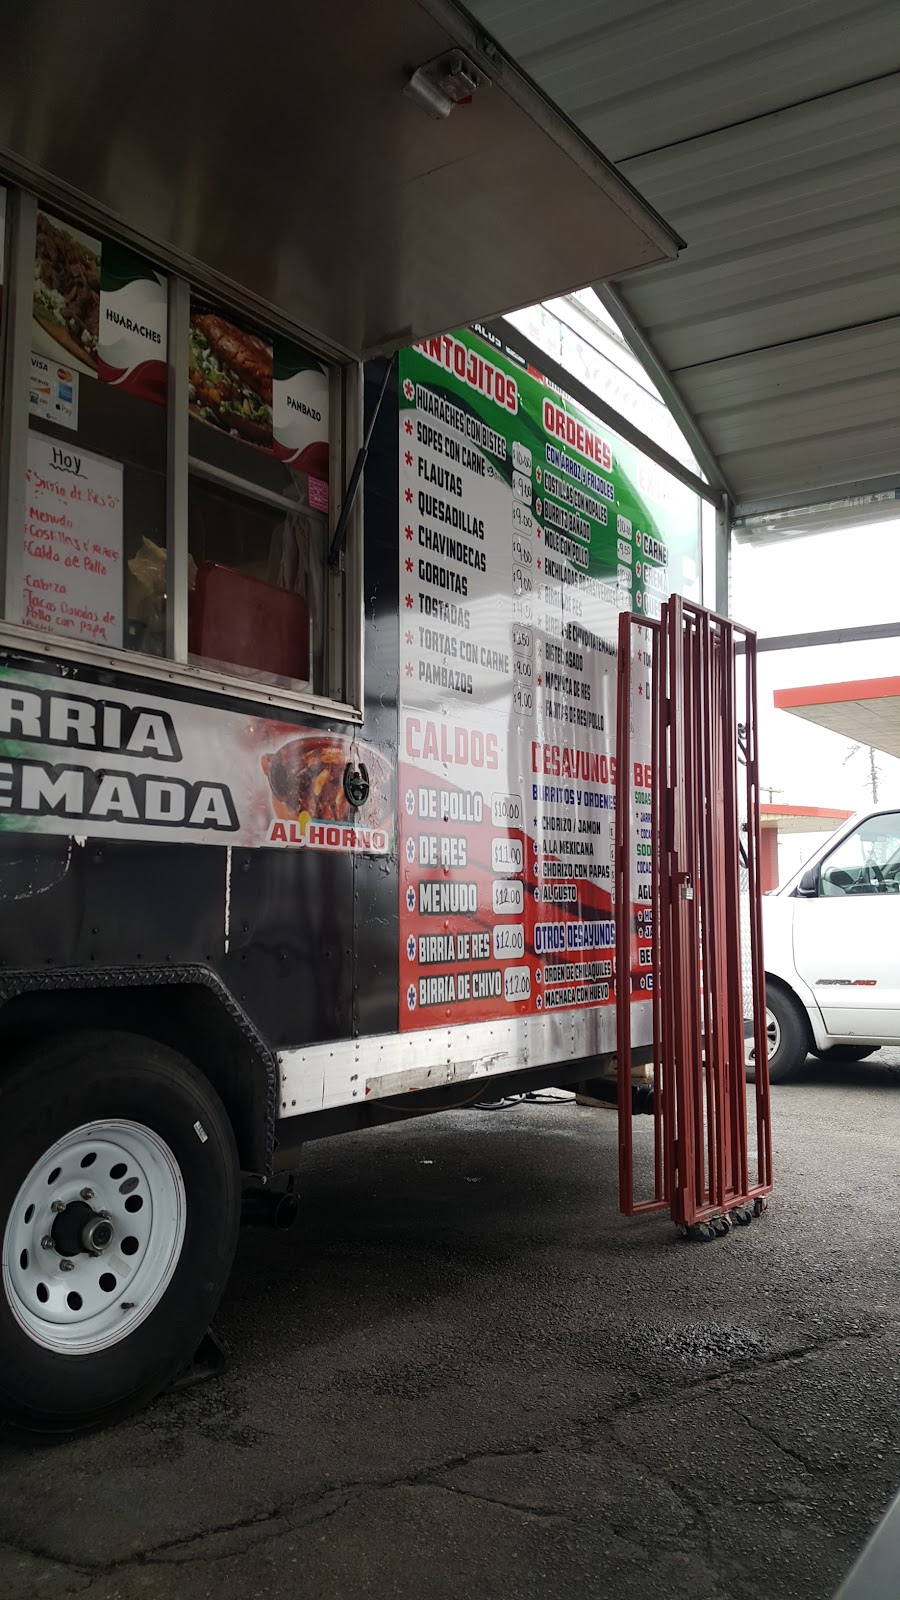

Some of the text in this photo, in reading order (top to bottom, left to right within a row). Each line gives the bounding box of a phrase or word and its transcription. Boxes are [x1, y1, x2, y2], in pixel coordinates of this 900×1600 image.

[106, 309, 161, 344] HUARACHES
[31, 359, 48, 372] VISA
[417, 386, 506, 458] HUARACHES CON BISTEC
[545, 402, 611, 470] ORDENES
[52, 447, 81, 474] Hoy
[417, 421, 442, 453] SOPES
[444, 437, 460, 462] CON
[462, 446, 485, 477] CARNE
[418, 456, 462, 497] FLAUTAS
[547, 445, 559, 465] CON
[561, 455, 581, 480] ARROZ
[587, 470, 613, 500] FRIJOLES
[29, 507, 73, 528] Menudo
[418, 491, 484, 540] QUESADILLAS
[418, 525, 486, 572] CHAVINDECAS
[644, 534, 667, 564] CARNE
[418, 559, 467, 596] GORDITAS
[23, 589, 56, 612] Tacos
[419, 593, 470, 629] TOSTADAS
[419, 627, 509, 673] TORTAS CON CARNE
[419, 661, 472, 694] PAMBAZOS
[581, 683, 590, 701] RES
[514, 692, 531, 708] $9.00
[406, 717, 498, 769] CALDOS
[532, 741, 616, 785] DESAYUNOS
[419, 788, 483, 822] DE POLLO
[494, 801, 519, 819] $10.00
[270, 822, 385, 850] AL HORNO
[542, 816, 571, 832] CHORIZO
[578, 820, 600, 835] JAMON
[419, 835, 466, 866] DE RES
[495, 846, 521, 865] $11.00
[542, 840, 594, 856] A LA MEXICANA
[542, 862, 572, 877] CHORIZO
[574, 863, 587, 878] CON
[589, 865, 610, 879] PAPAS
[419, 883, 477, 912] MENUDO
[495, 888, 521, 906] $12.00
[543, 885, 576, 900] AL GUSTO
[419, 933, 490, 962] BIRRIA DE RES
[496, 931, 522, 949] $12.00
[535, 923, 616, 950] OTROS DESAYUNOS
[505, 975, 530, 995] $12.00
[545, 962, 611, 982] ORDEN DE CHILAQUILES
[419, 971, 501, 1005] BIRRIA DE CHIVO
[545, 984, 608, 1006] MACHACA CON HUEVO
